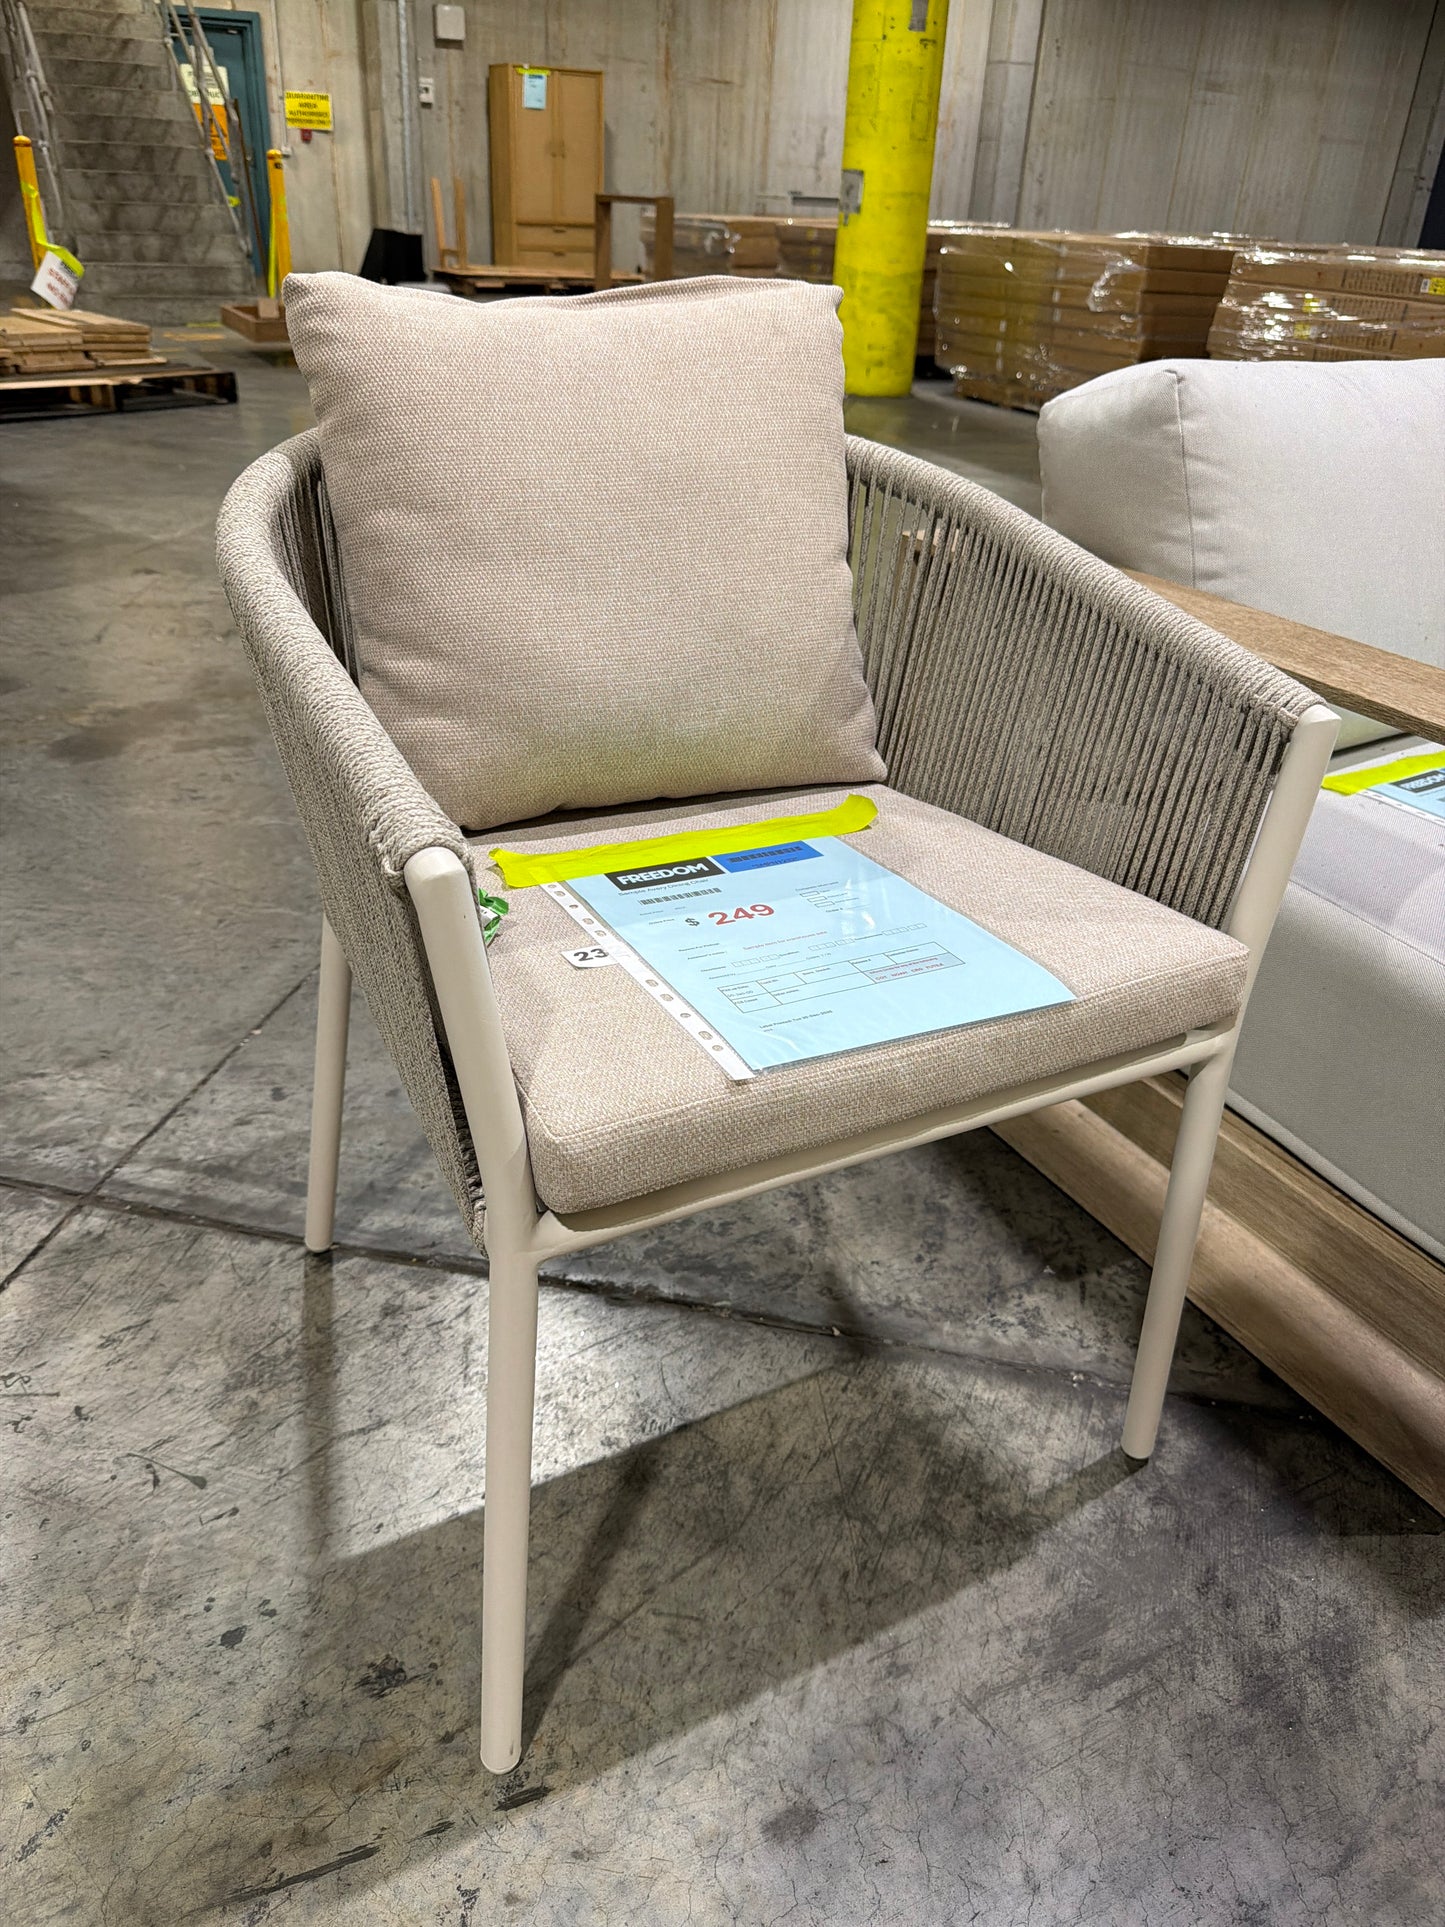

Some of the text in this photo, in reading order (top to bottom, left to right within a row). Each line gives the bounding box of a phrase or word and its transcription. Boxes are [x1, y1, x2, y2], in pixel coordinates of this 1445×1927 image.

[616, 862, 710, 885] FREEDOM
[684, 917, 700, 928] $
[708, 904, 775, 926] 249
[573, 948, 610, 962] 23
